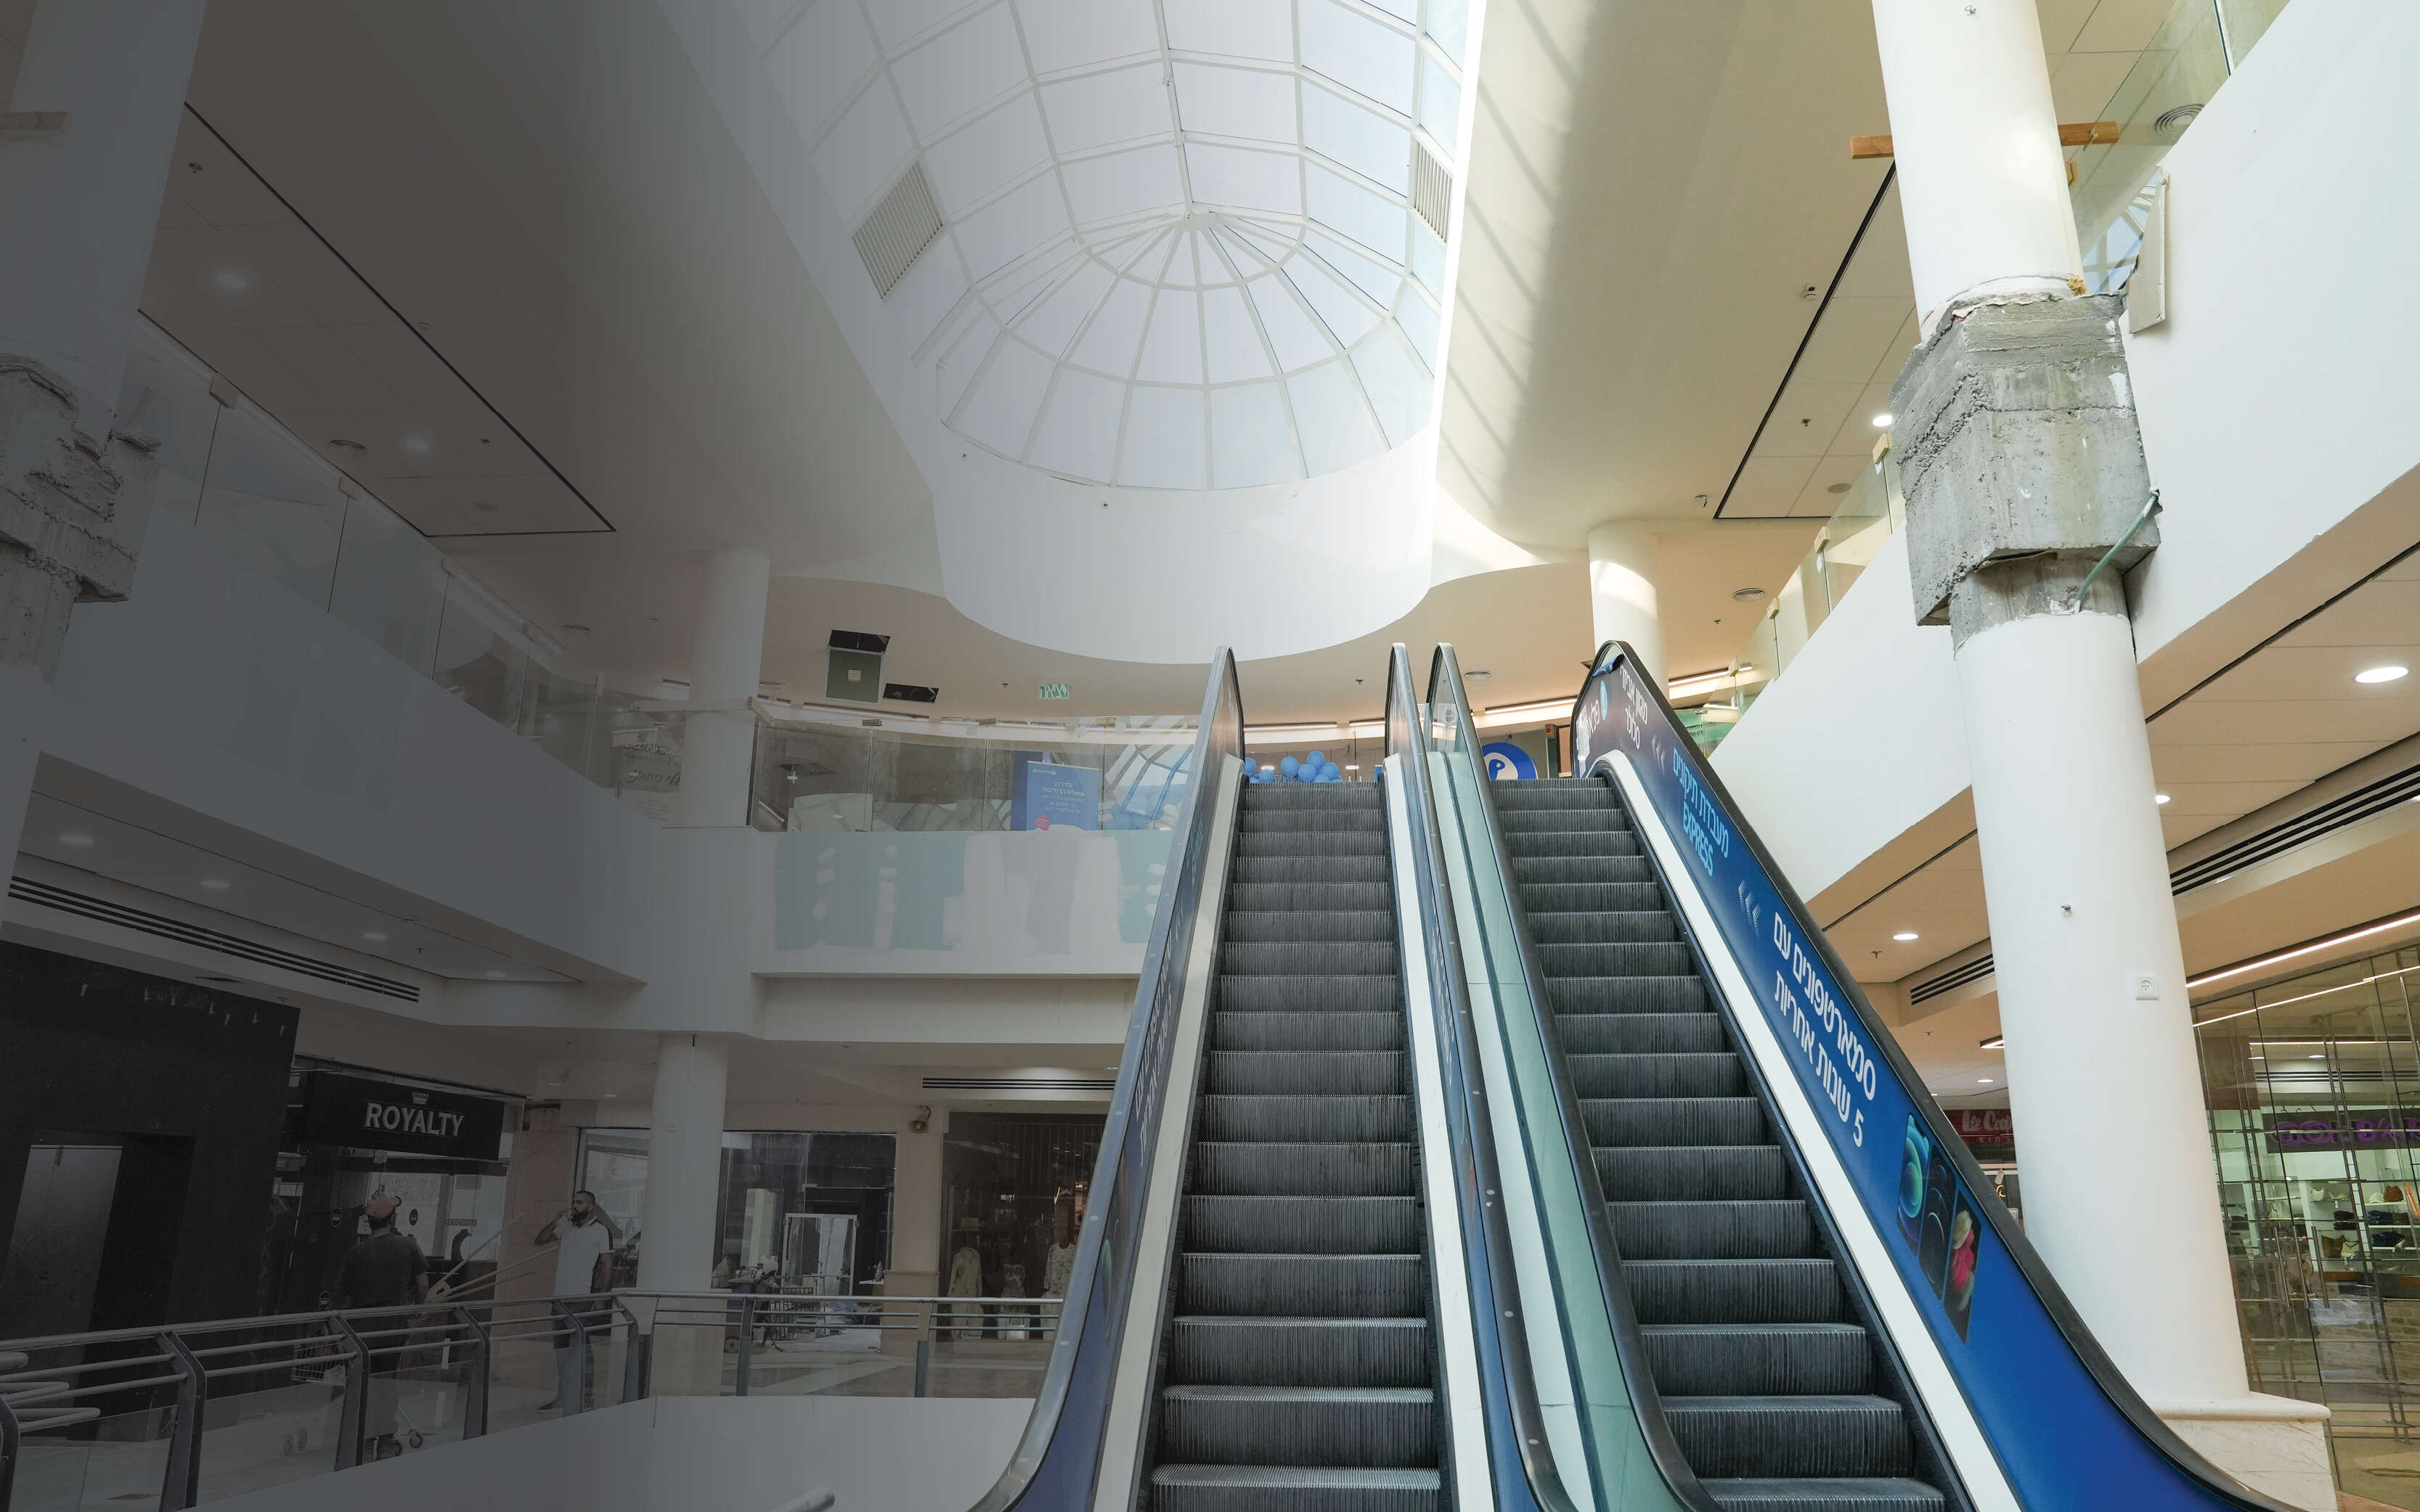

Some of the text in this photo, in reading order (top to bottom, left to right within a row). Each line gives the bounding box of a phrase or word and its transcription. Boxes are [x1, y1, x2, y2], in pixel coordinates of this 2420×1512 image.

[1625, 705, 1640, 750] סלולר
[1635, 687, 1648, 726] מגוון
[1673, 747, 1698, 809] תיקונים
[1683, 801, 1714, 877] EXPRESS
[1699, 789, 1729, 859] מעבדת
[1774, 912, 1876, 1101] סמארטפונים עם
[1774, 970, 1865, 1148] 5 שנות אחריות
[364, 1102, 465, 1137] ROYALTY
